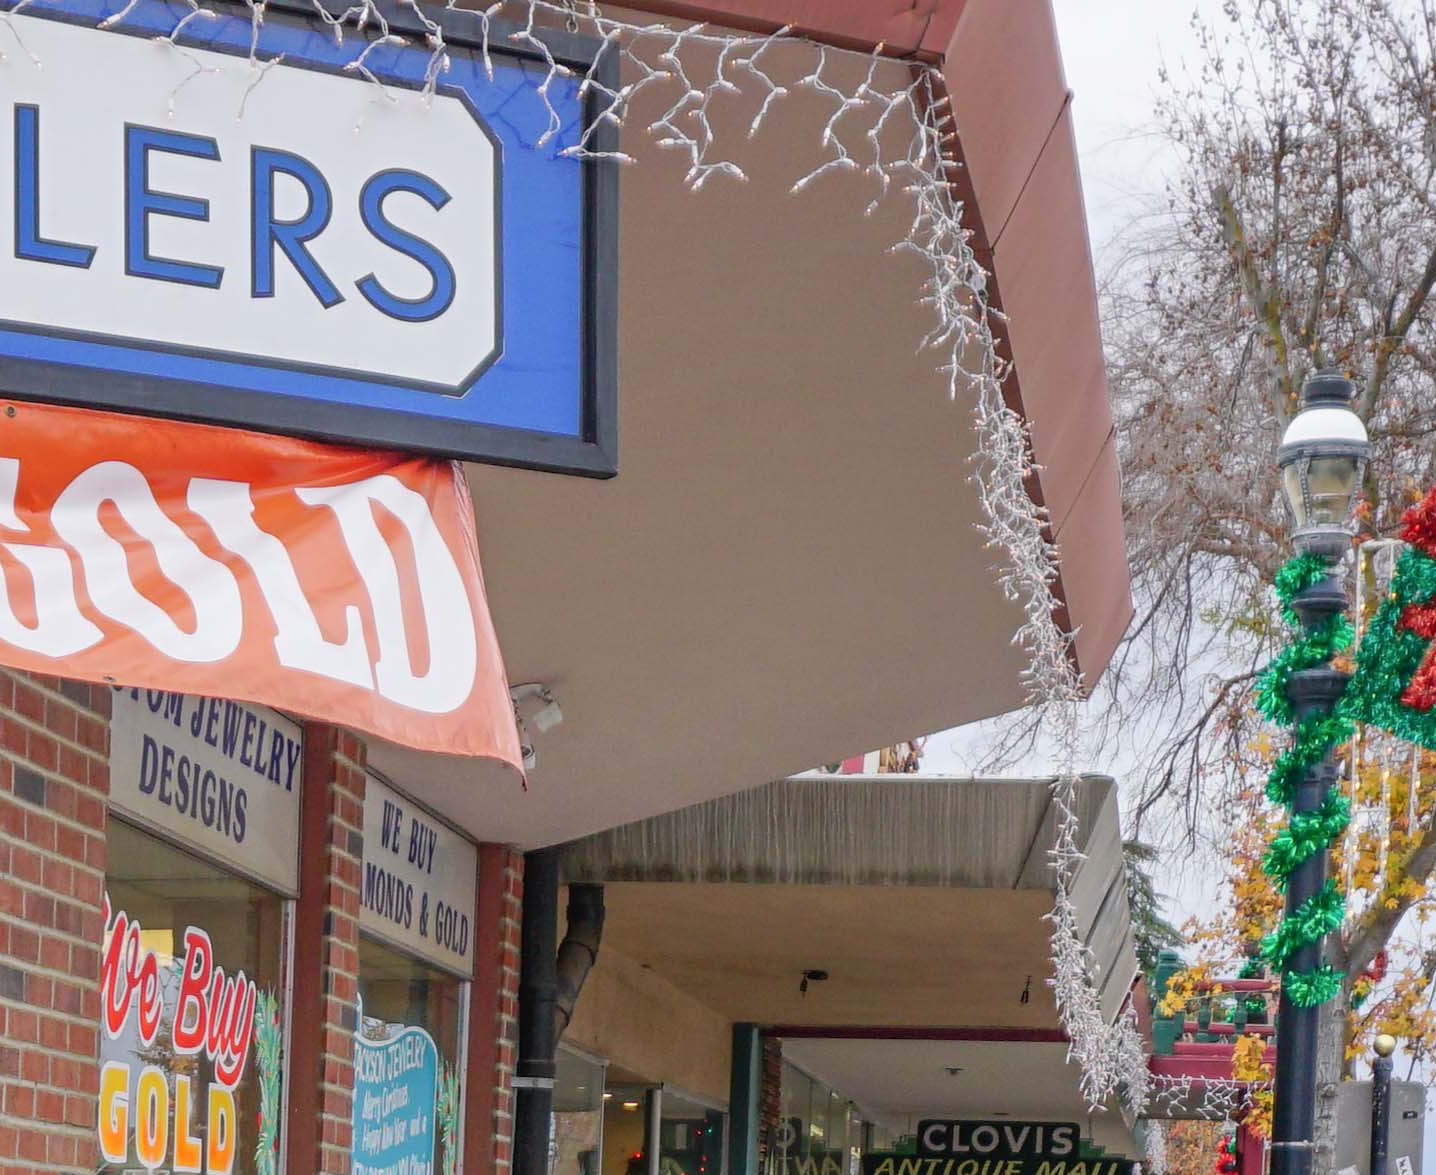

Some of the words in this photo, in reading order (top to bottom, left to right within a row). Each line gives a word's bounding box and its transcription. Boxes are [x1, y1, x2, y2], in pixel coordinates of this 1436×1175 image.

[138, 733, 248, 844] DESIGNS
[191, 696, 303, 793] JEWELRY
[381, 799, 402, 855] WE
[408, 817, 437, 876] BUY
[360, 862, 413, 930] MONDS
[419, 892, 429, 939] &
[435, 900, 469, 957] GOLD
[172, 925, 257, 1092] Buy
[922, 1124, 1075, 1155] CLOVIS
